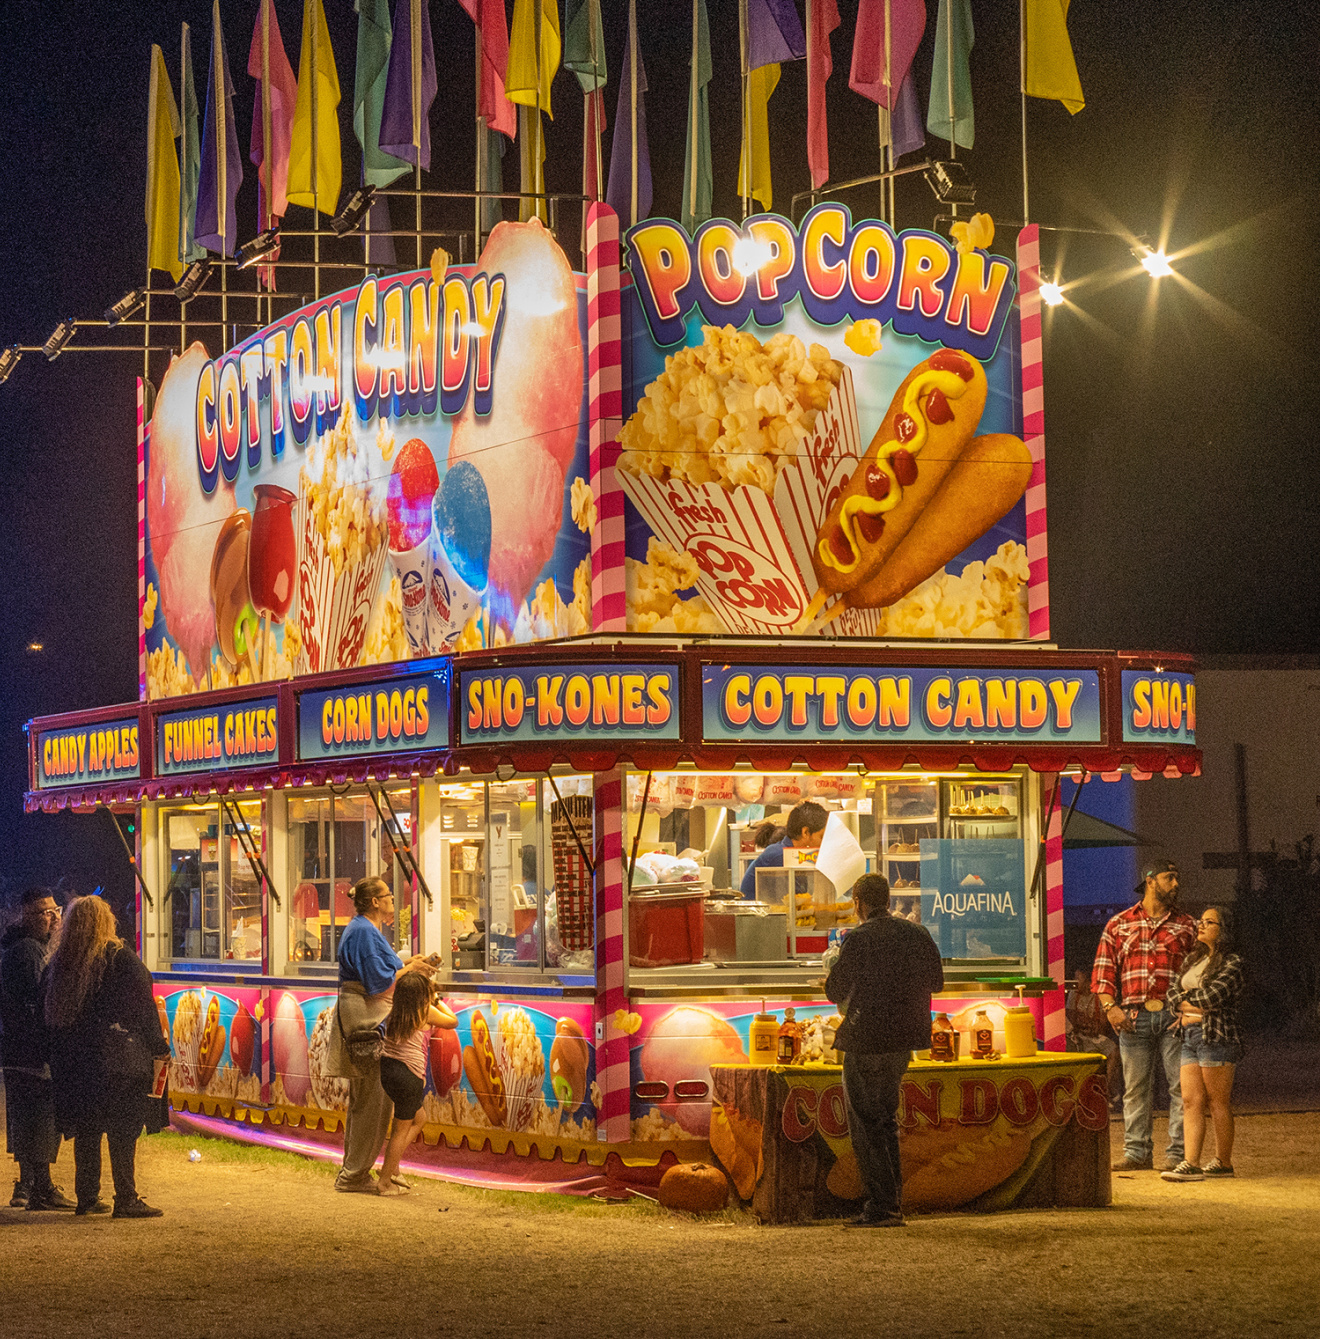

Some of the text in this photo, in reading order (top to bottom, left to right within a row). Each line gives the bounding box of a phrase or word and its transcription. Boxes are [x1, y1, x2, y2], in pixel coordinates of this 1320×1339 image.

[198, 277, 505, 478] COTTON CANDY
[688, 540, 756, 583] POP
[716, 577, 801, 618] CORN
[321, 686, 429, 745] CORN DOGS
[467, 674, 671, 731] SNO-KONES
[724, 673, 1081, 730] COTTON CANDY
[43, 726, 139, 777] CANDY APPLES
[164, 707, 277, 765] FUNNEL CAKES
[931, 891, 1015, 917] AQUAFINA
[781, 1073, 1109, 1143] CON DOGS
